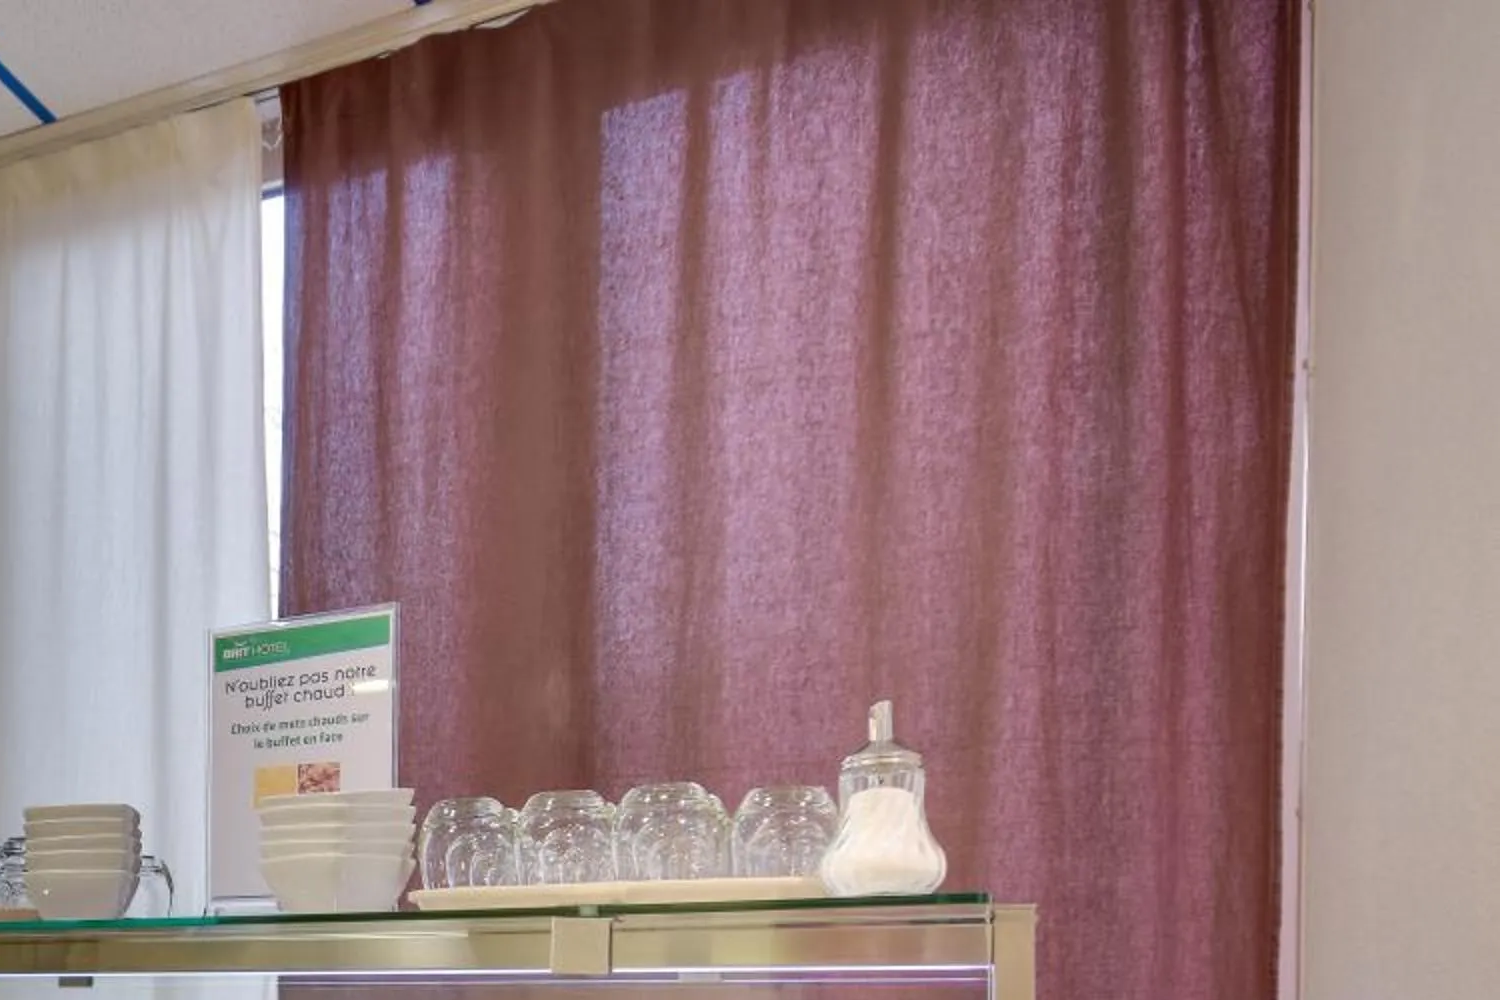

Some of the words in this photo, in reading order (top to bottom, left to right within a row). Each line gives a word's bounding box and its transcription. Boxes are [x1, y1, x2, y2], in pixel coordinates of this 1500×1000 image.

[225, 675, 295, 694] N'oubliez
[299, 671, 329, 686] pas
[334, 665, 377, 681] notre
[245, 690, 288, 711] buffet
[293, 684, 345, 703] chaud
[231, 721, 260, 735] Choix
